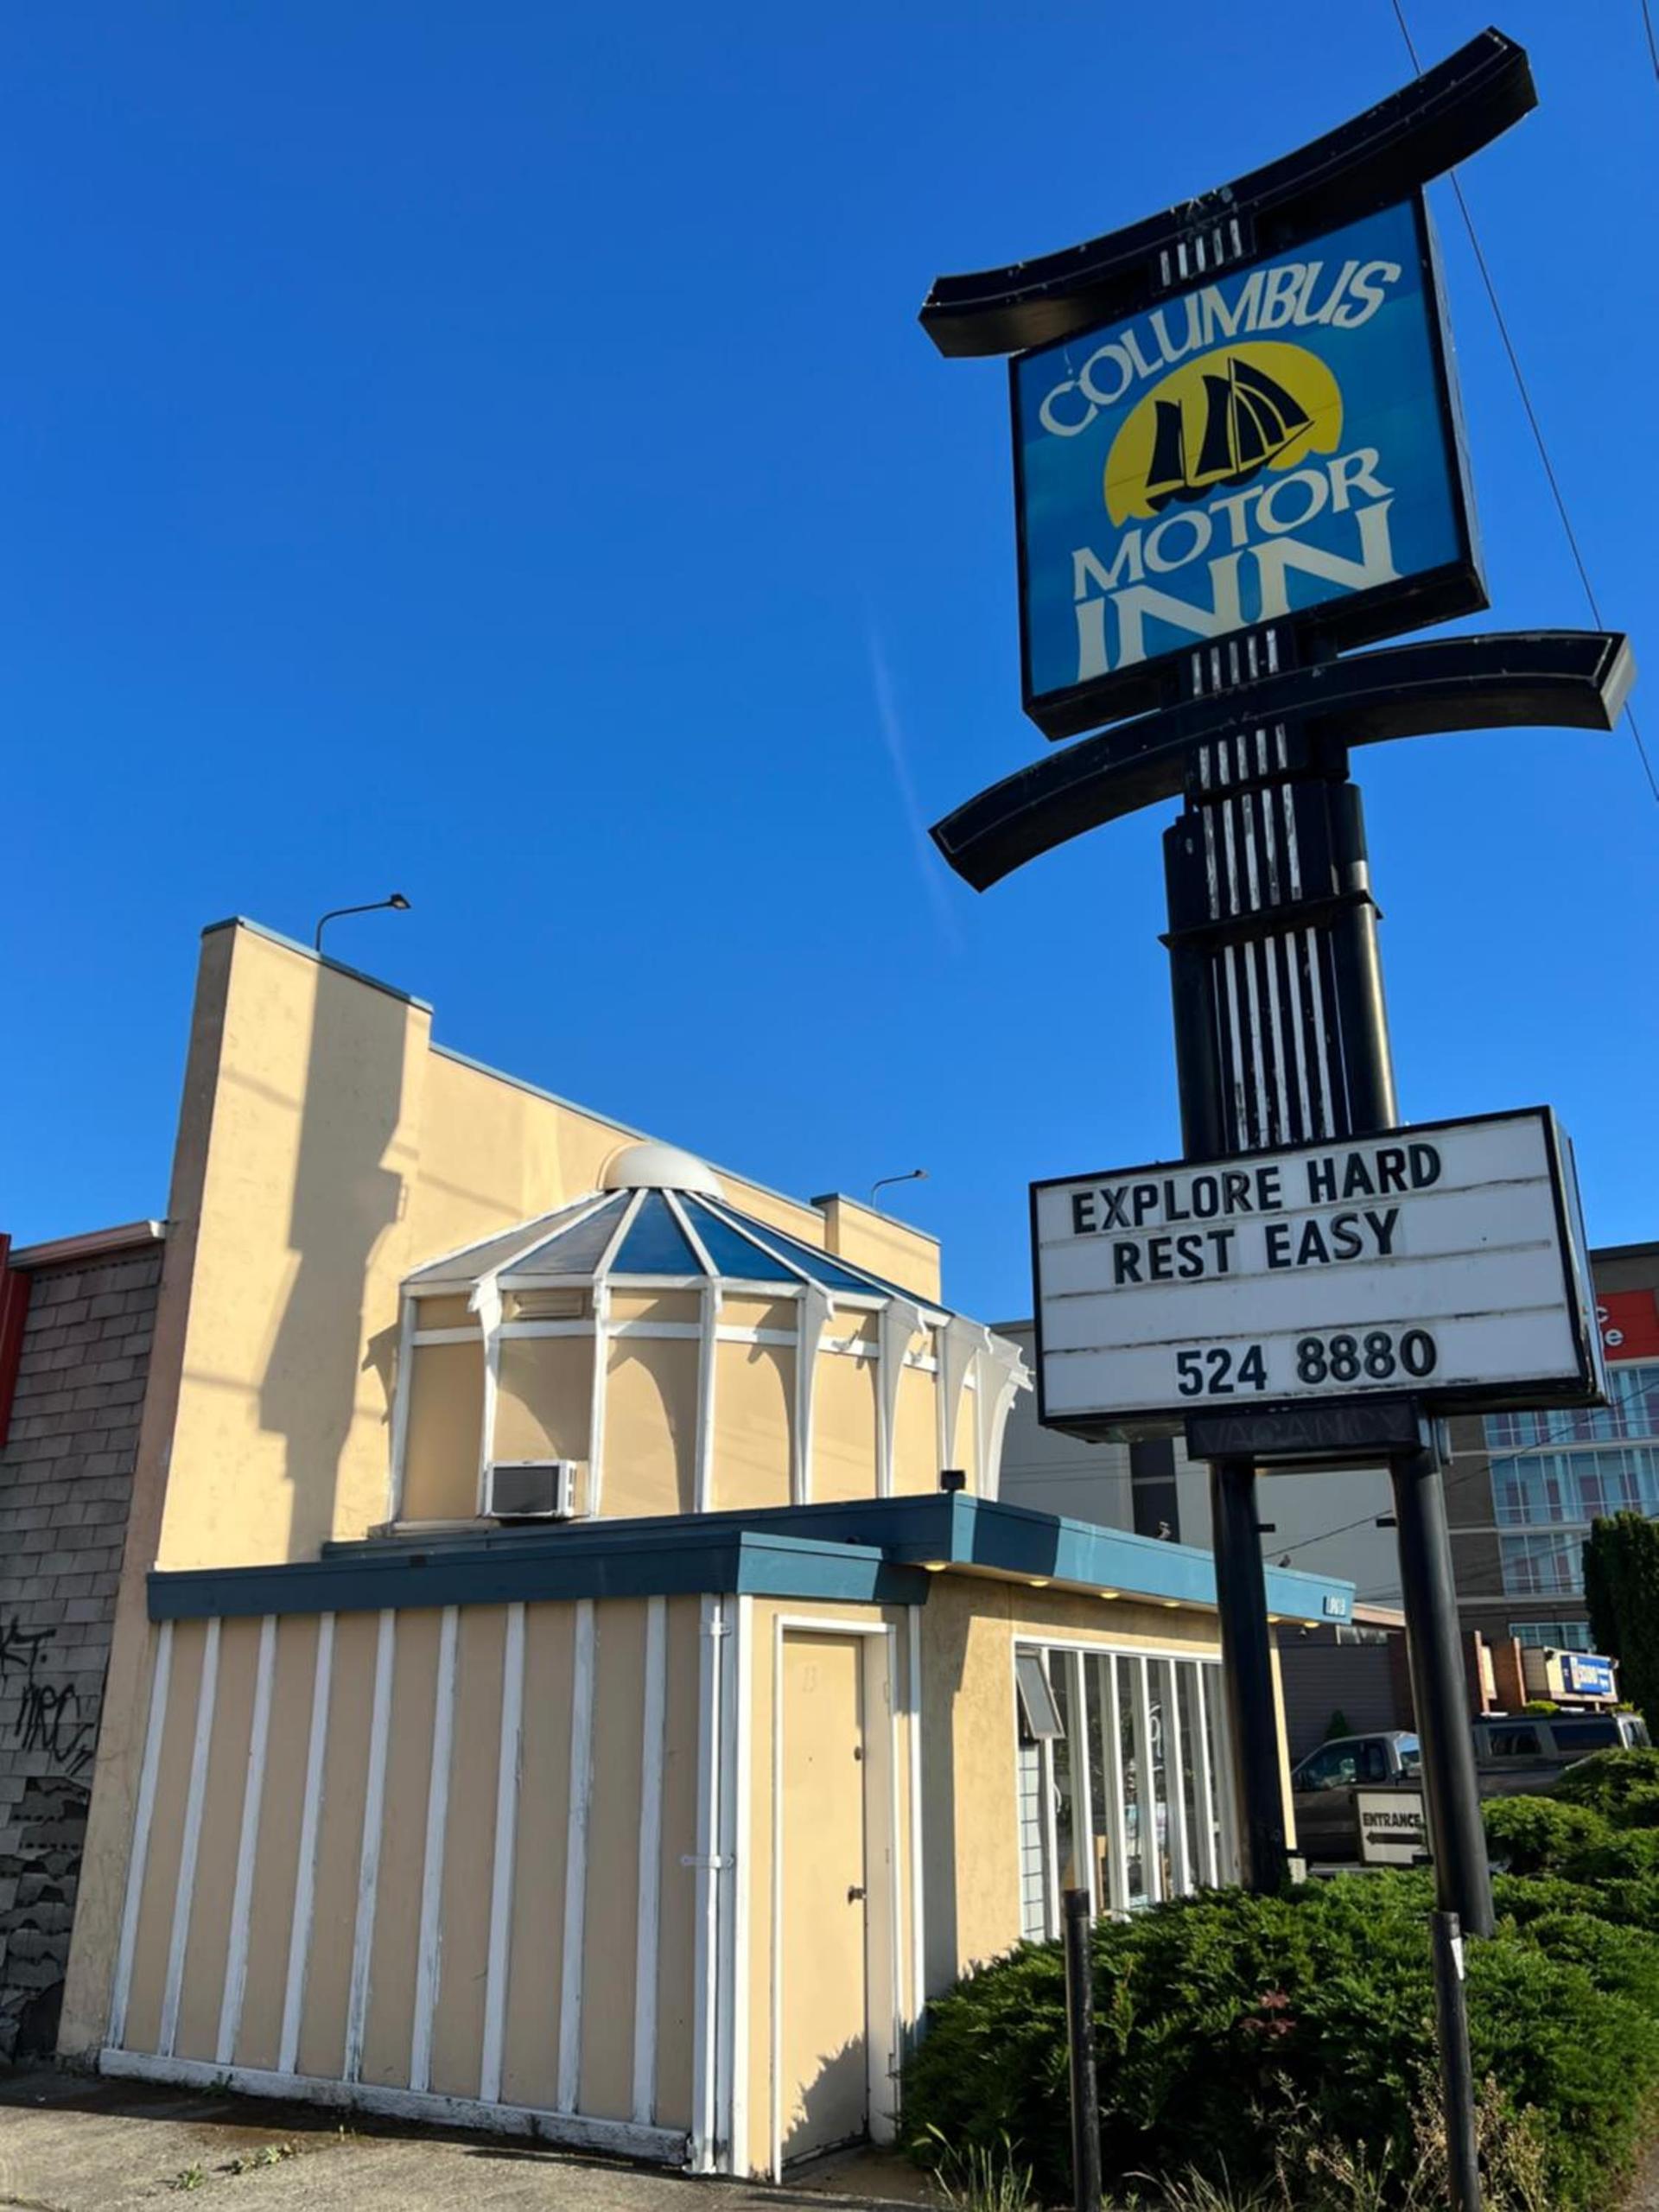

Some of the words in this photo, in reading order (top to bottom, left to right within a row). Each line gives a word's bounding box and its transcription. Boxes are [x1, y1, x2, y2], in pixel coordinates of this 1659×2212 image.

[1039, 260, 1402, 436] COLUMBUS
[1071, 447, 1394, 601] MOTOR
[1075, 498, 1402, 682] INN
[1072, 1166, 1283, 1234] EXPLORE
[1306, 1142, 1441, 1205] HARD
[1113, 1229, 1235, 1284] REST
[1266, 1208, 1400, 1269] EASY
[1176, 1344, 1267, 1396] 524
[1296, 1328, 1437, 1384] 8880
[1363, 1812, 1421, 1828] ENTRANCE
